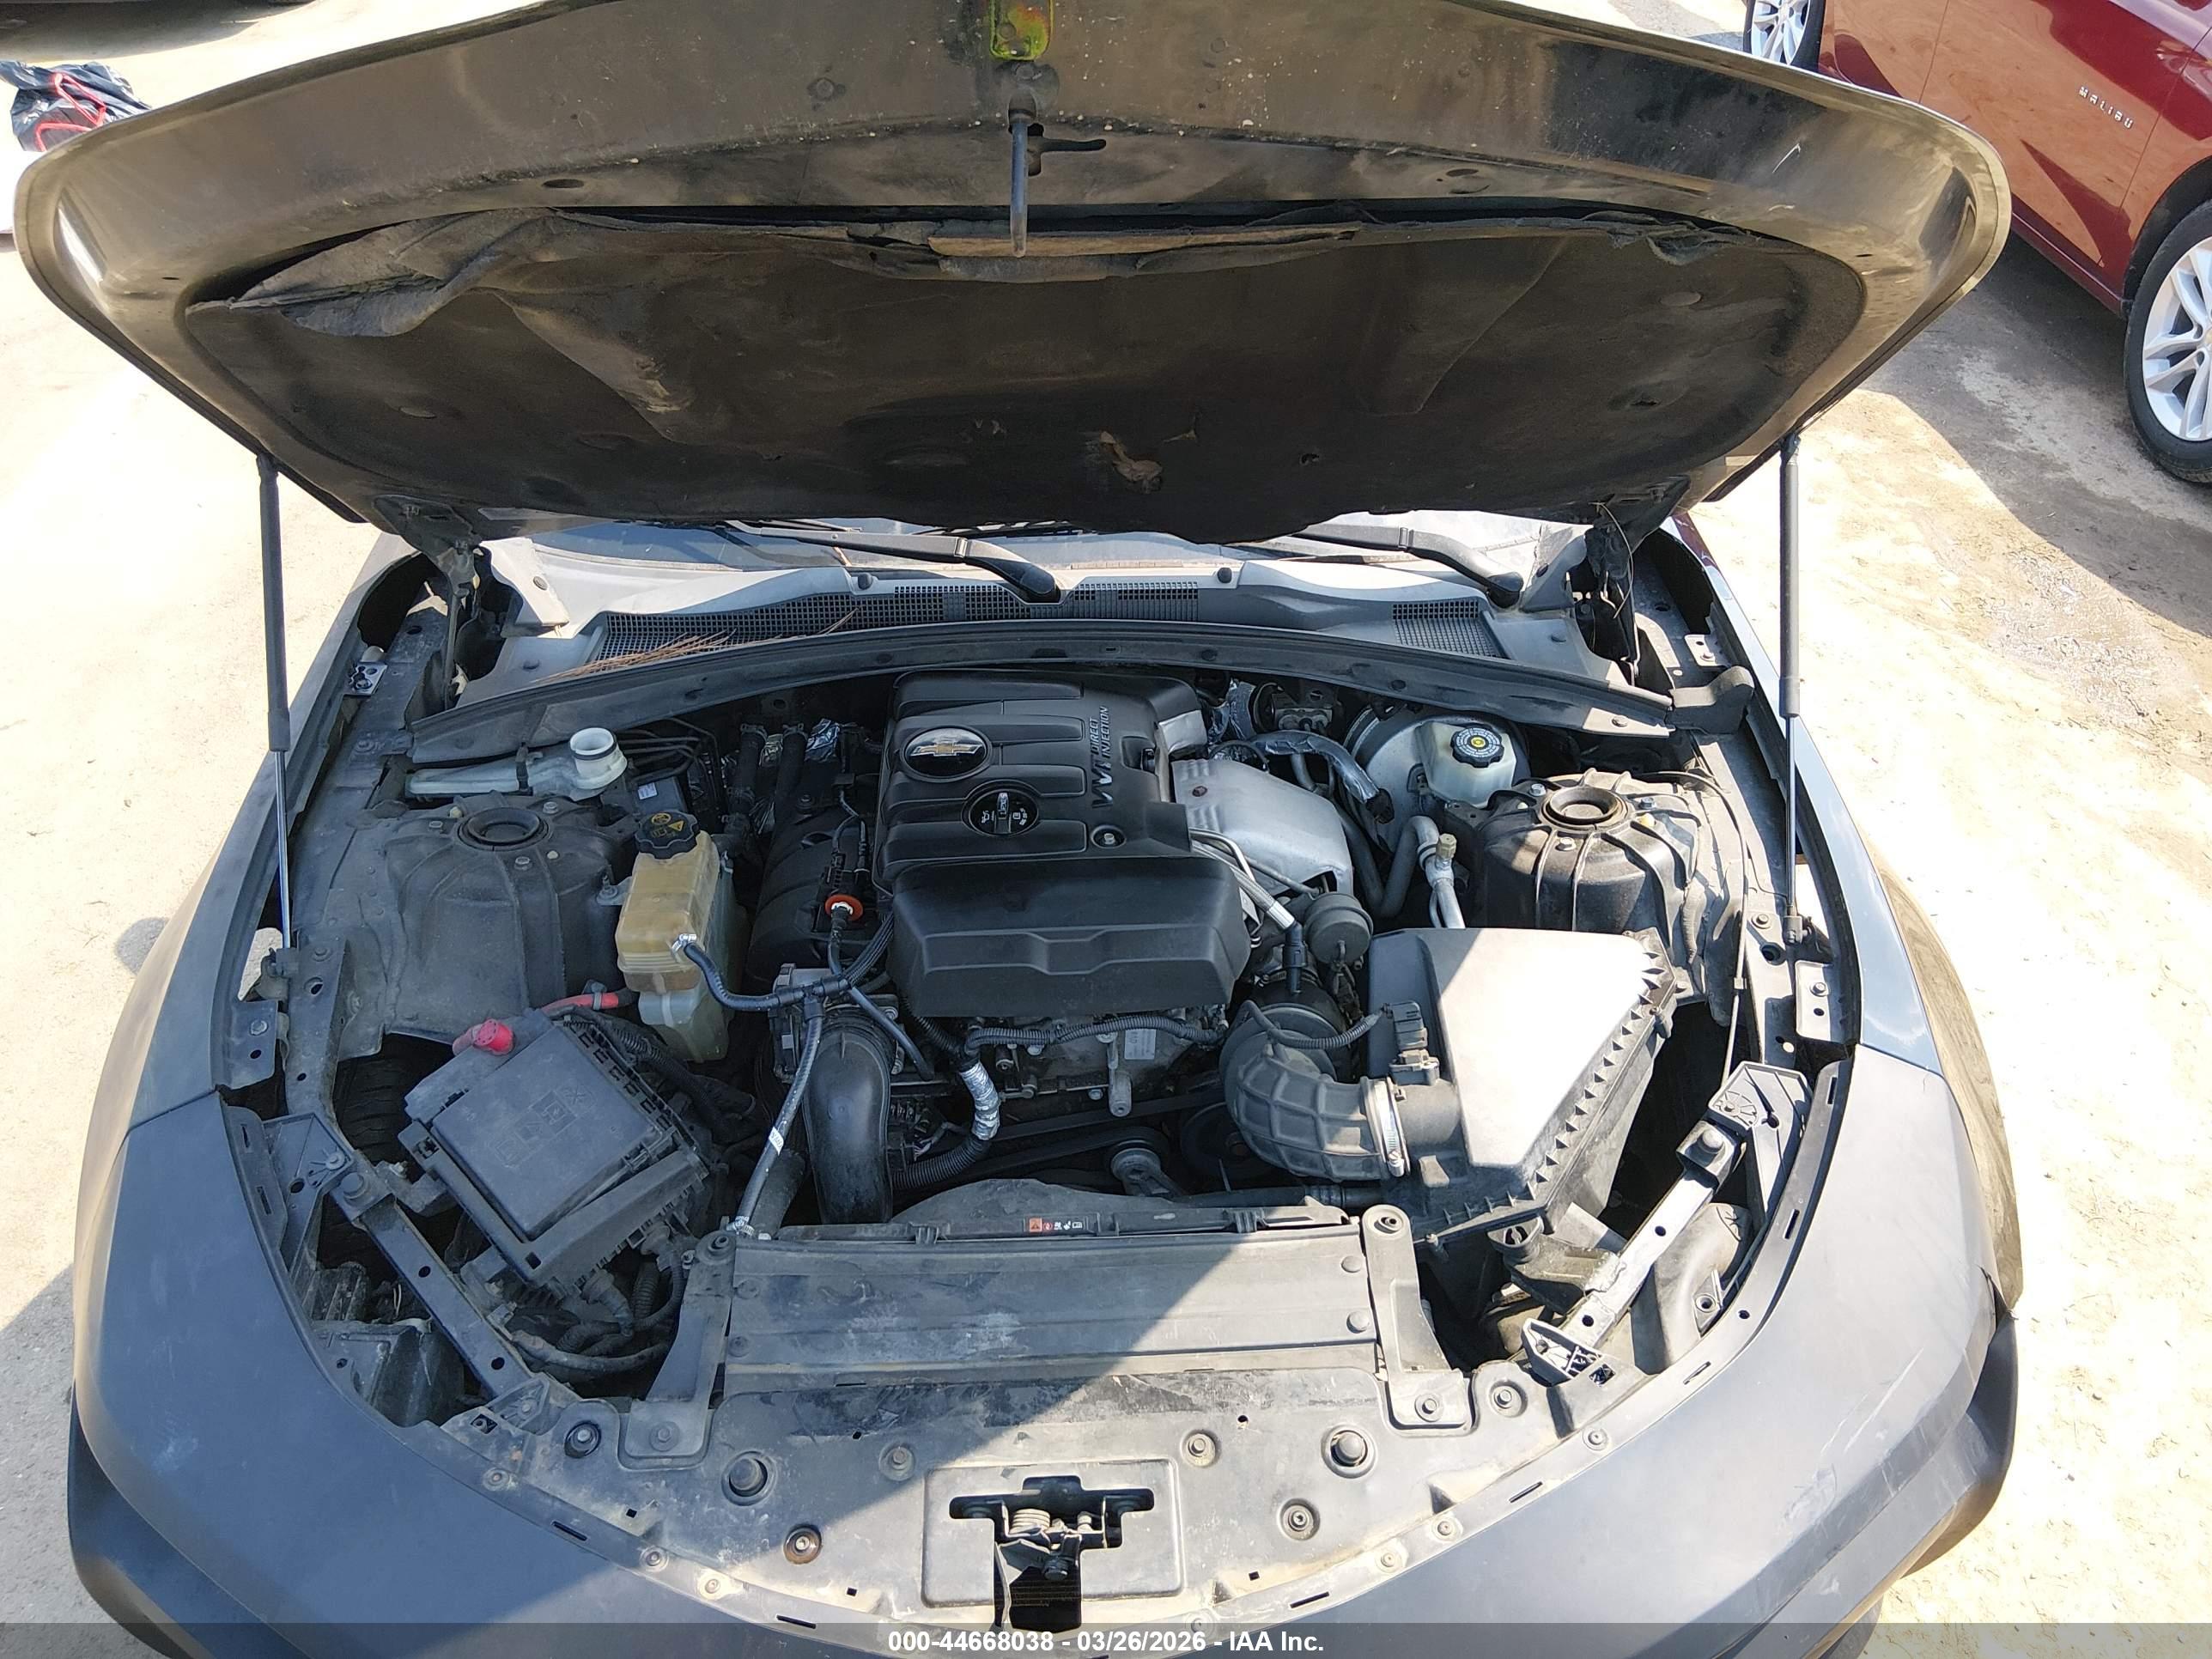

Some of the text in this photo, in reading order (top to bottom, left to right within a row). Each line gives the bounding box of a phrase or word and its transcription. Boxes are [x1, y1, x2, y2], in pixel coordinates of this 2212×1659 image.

[2079, 86, 2134, 129] MALIBU
[1090, 717, 1099, 755] DIRECT
[1100, 706, 1110, 758] INJECTION
[1091, 755, 1113, 809] VVT
